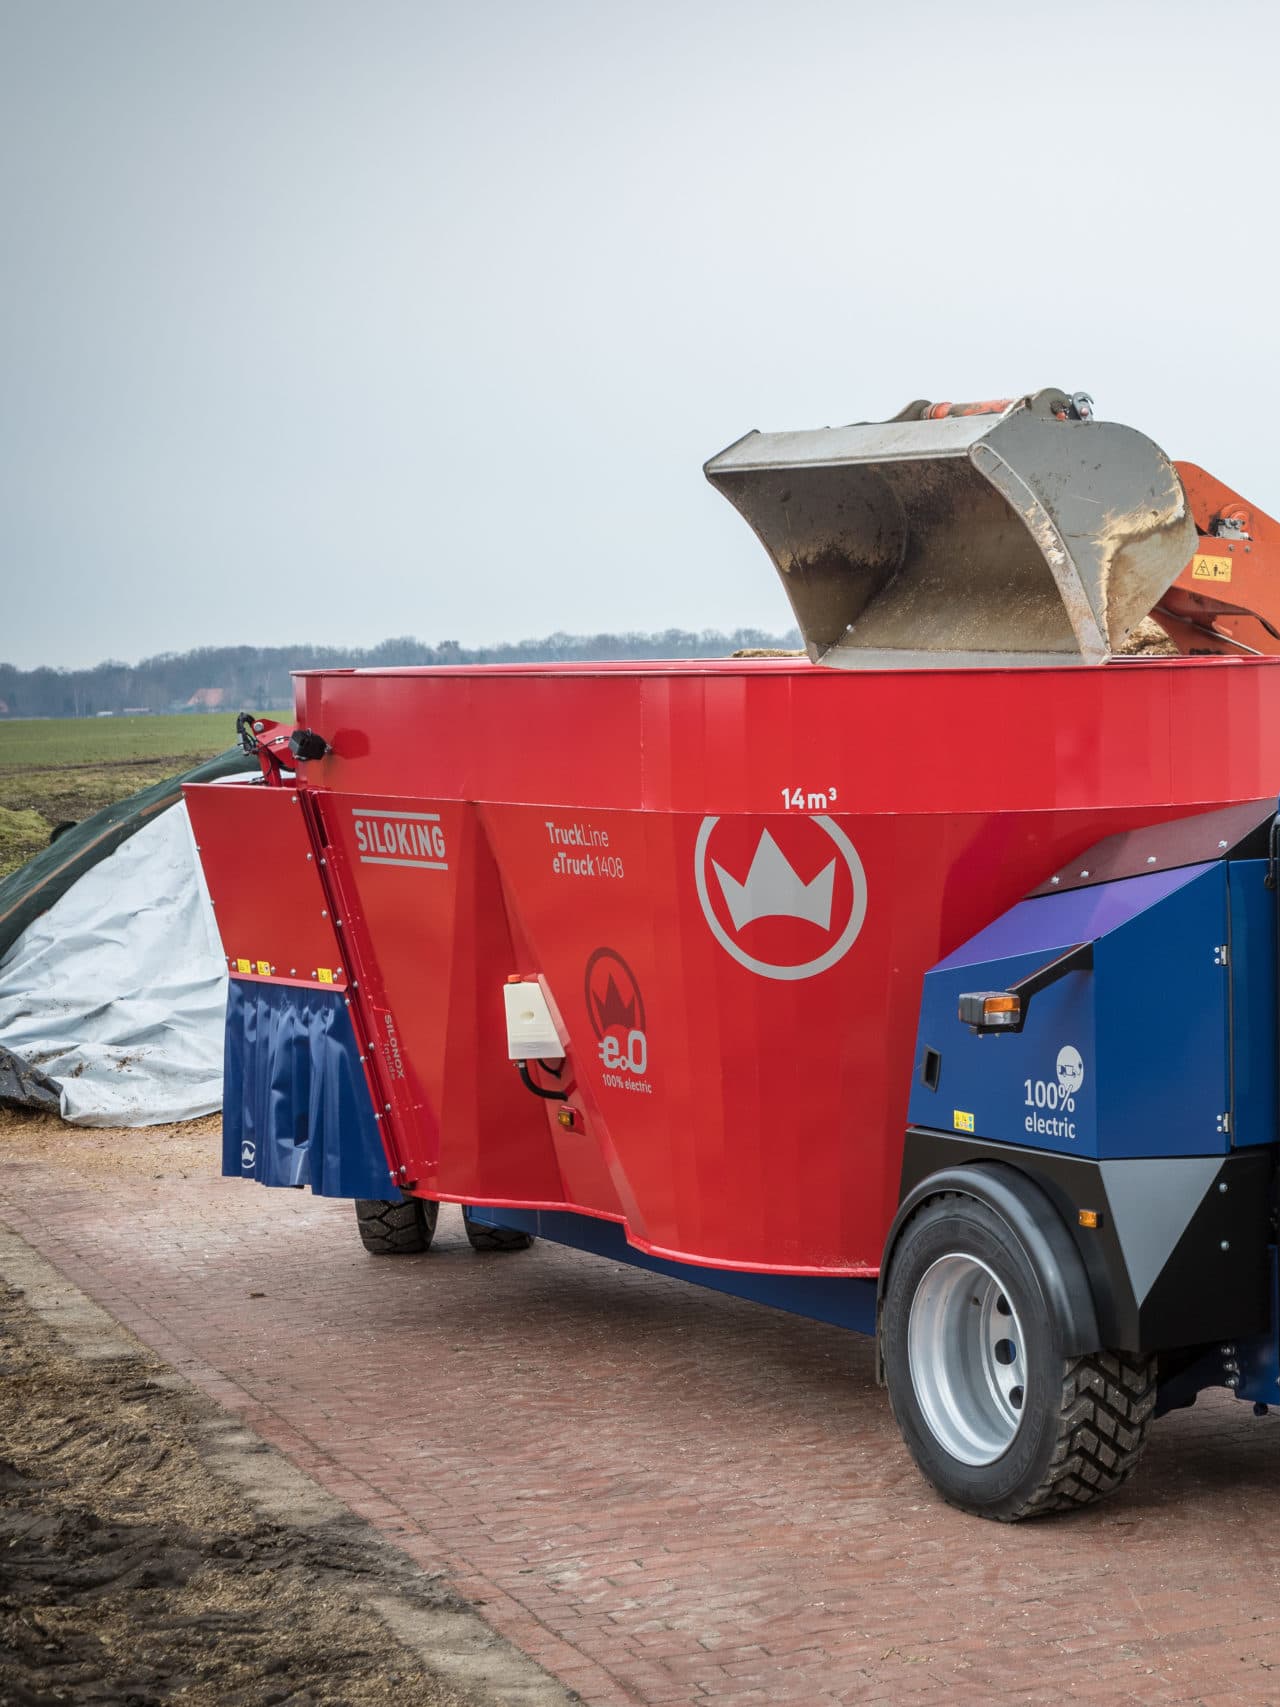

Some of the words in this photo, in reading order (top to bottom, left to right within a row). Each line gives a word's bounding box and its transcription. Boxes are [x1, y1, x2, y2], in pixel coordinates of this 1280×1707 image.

[355, 820, 446, 857] SILOKING
[545, 822, 608, 847] TruckLine
[553, 852, 594, 876] eTruck
[596, 856, 624, 878] 1408
[385, 1014, 405, 1078] SILONOX
[602, 1073, 624, 1089] 100%
[625, 1077, 652, 1093] electric
[1024, 1079, 1075, 1112] 100%
[1025, 1111, 1076, 1138] electric
